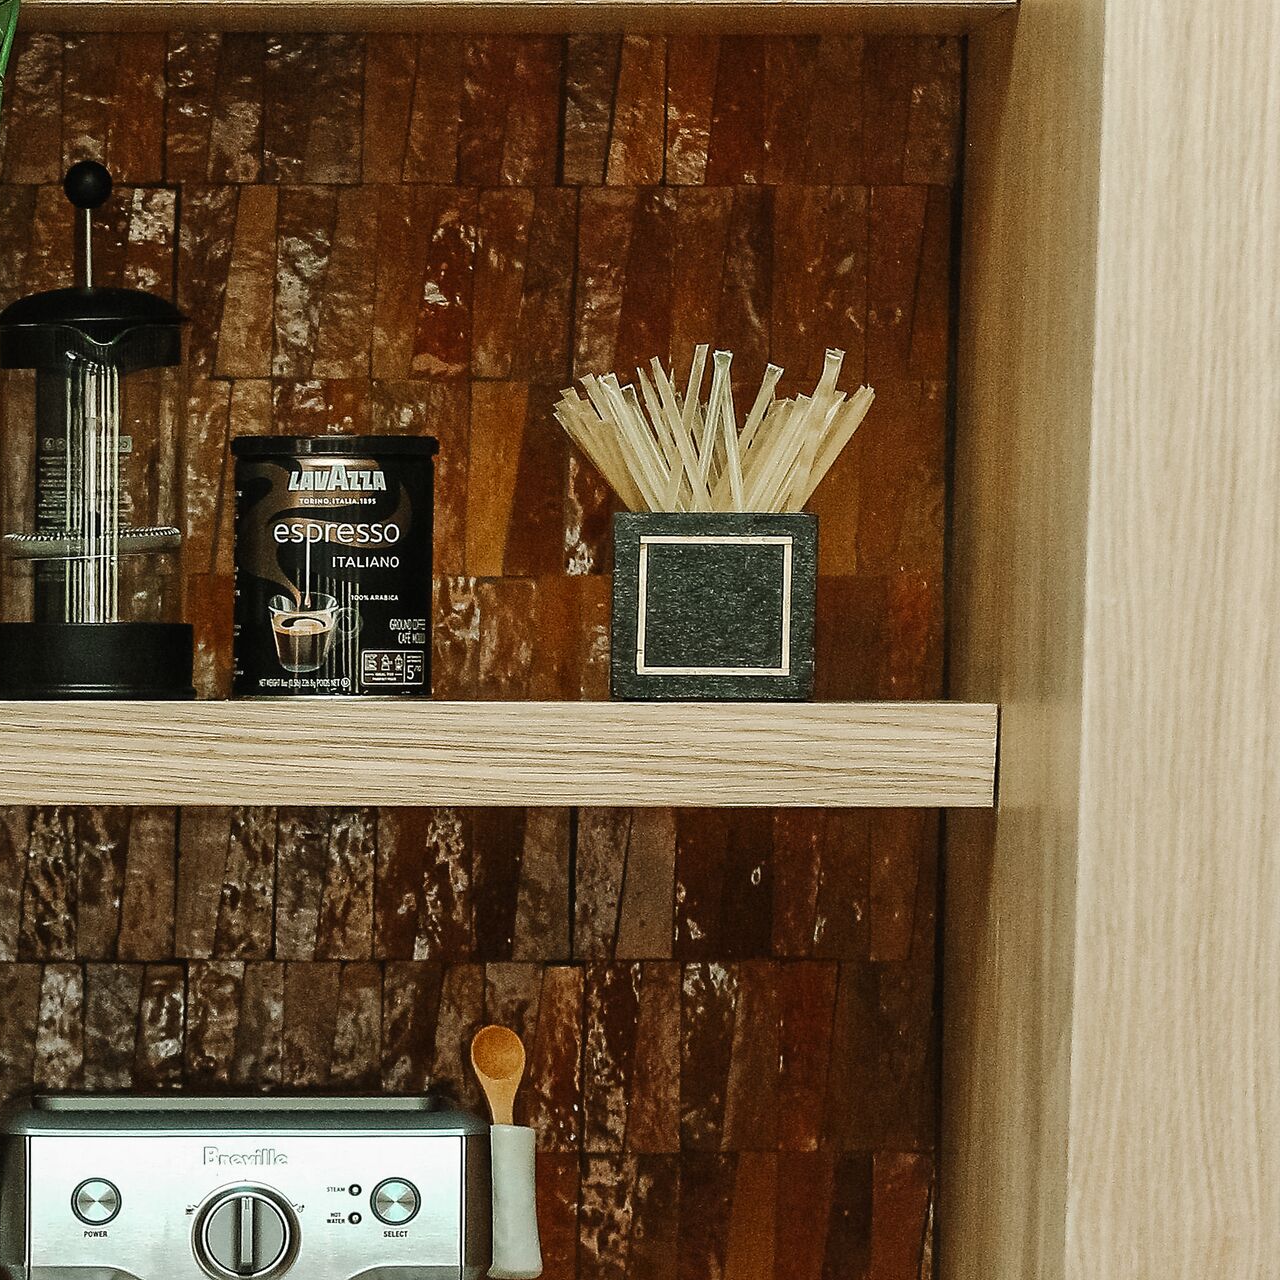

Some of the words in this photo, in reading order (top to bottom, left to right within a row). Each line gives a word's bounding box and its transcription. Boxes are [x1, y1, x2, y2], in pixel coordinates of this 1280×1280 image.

[288, 464, 387, 491] LAVAZZA
[360, 497, 377, 505] 1895
[273, 523, 400, 547] espresso
[332, 556, 400, 568] ITALIANO
[203, 1146, 288, 1166] Breville
[83, 1230, 108, 1238] POWER
[383, 1230, 409, 1238] SELECT
